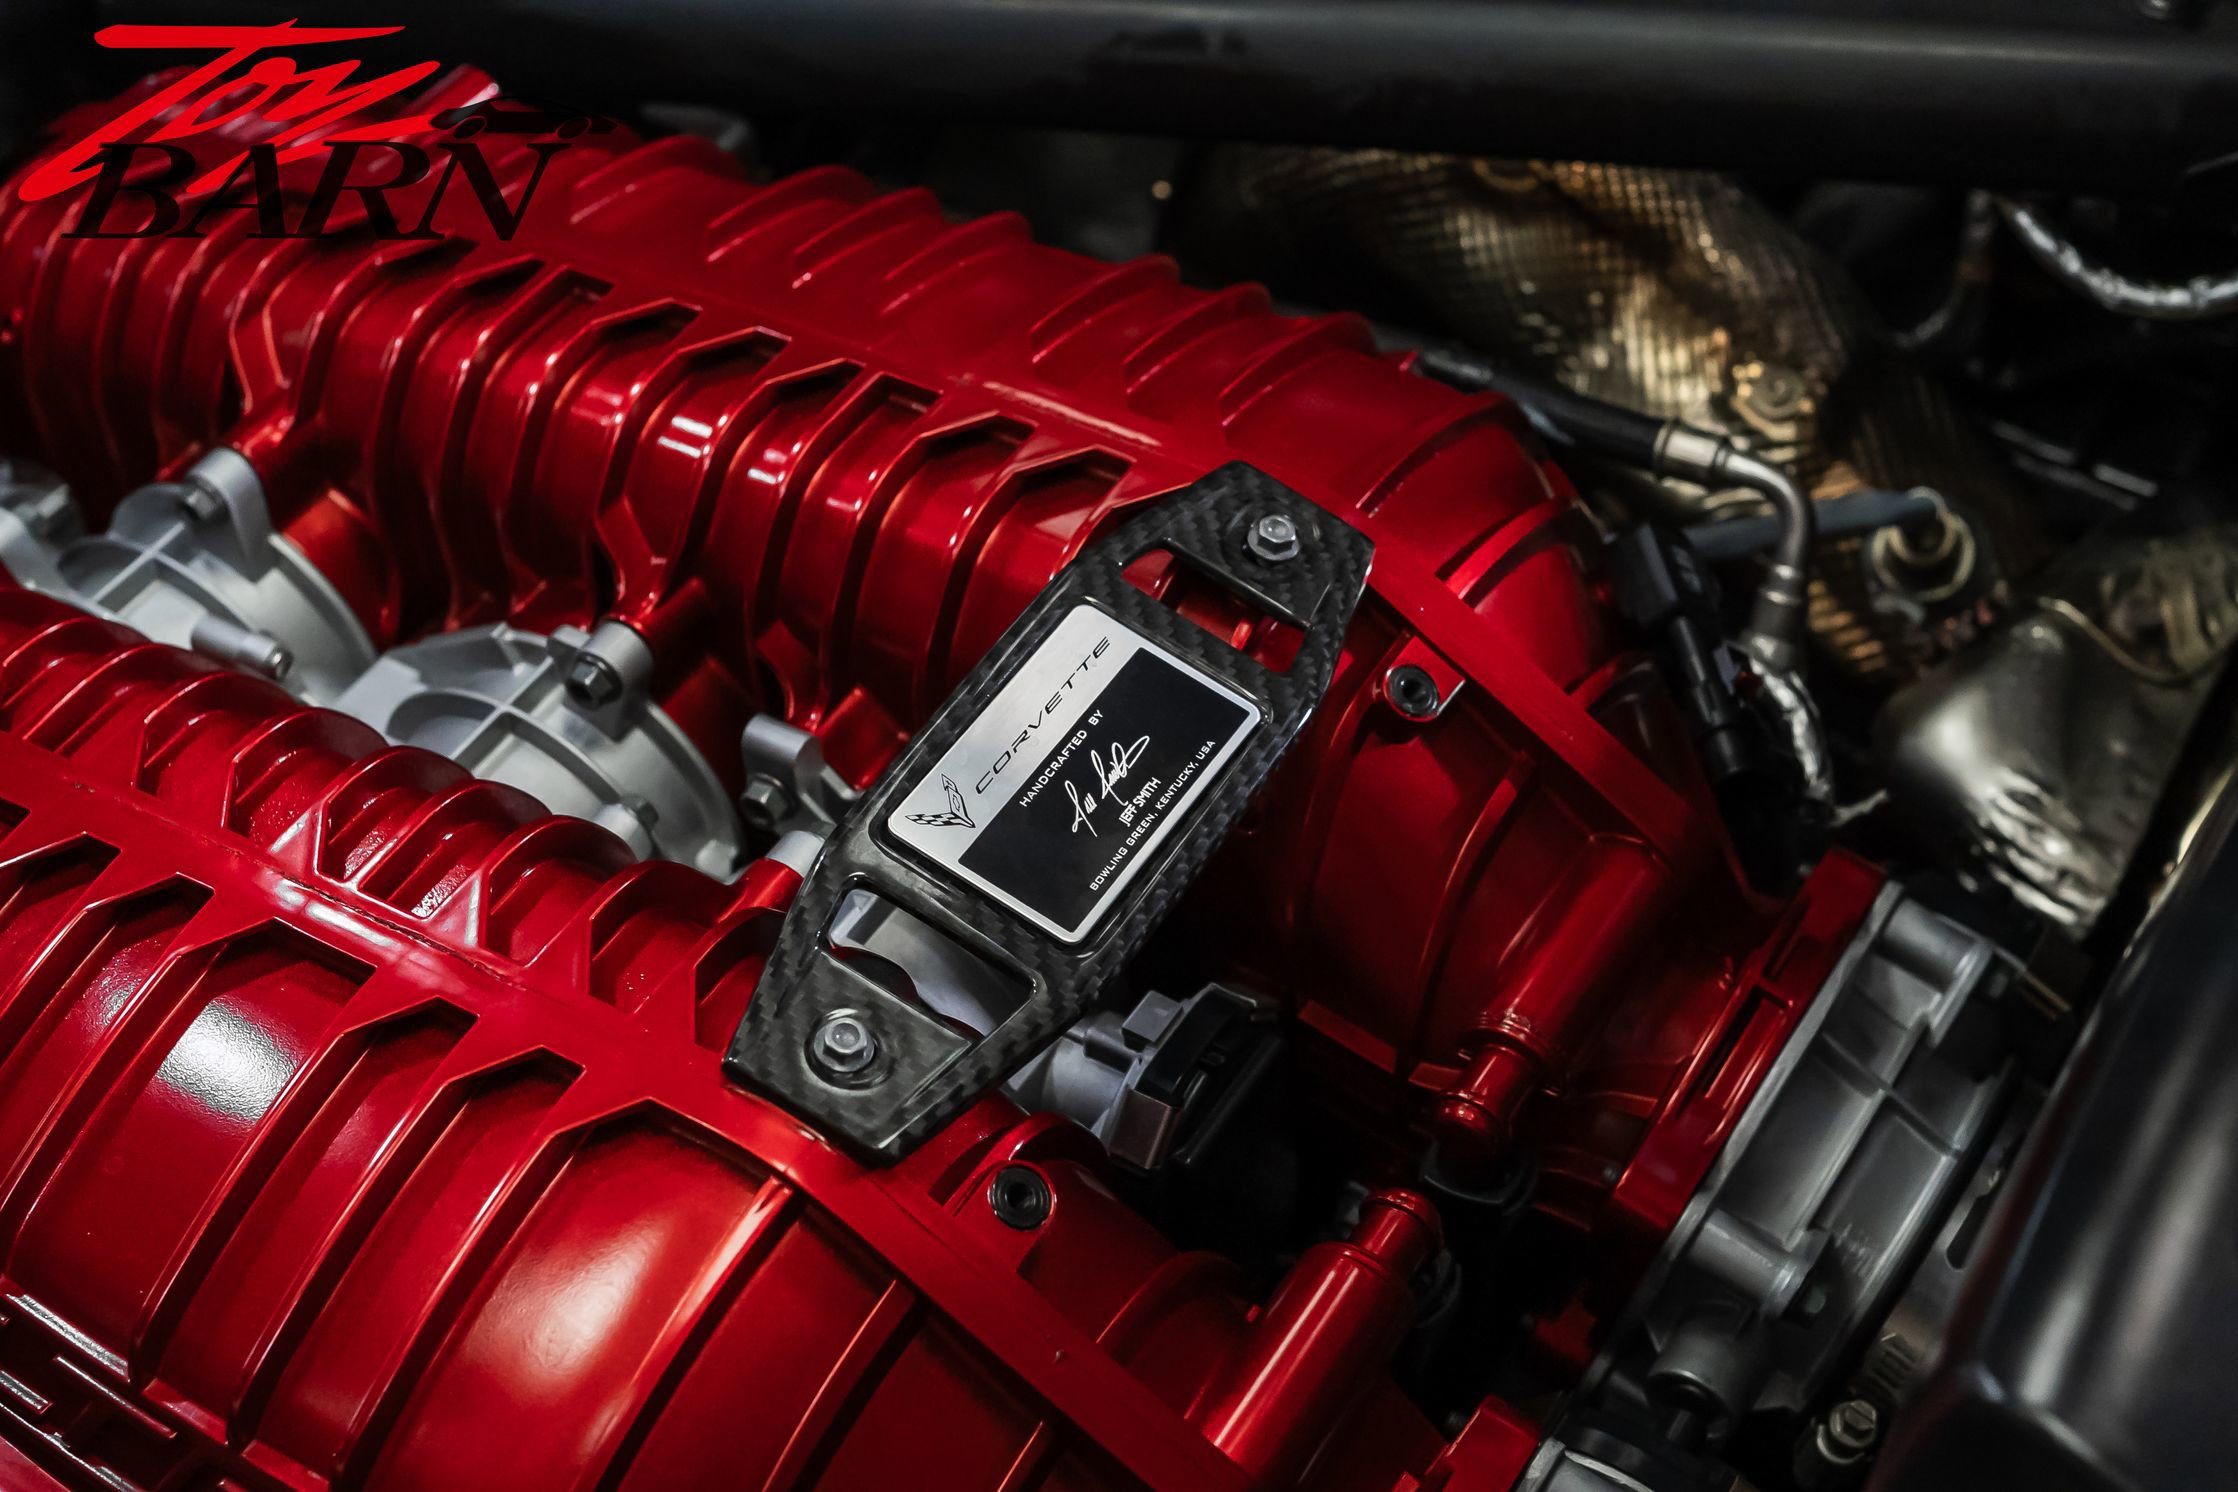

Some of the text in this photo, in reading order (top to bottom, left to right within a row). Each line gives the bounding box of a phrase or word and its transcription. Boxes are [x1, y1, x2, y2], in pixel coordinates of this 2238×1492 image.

[975, 636, 1111, 794] CORVETTE
[1019, 709, 1103, 807] HANDCRAFTED BY
[1089, 740, 1216, 891] BOWLING GREEN, KENTUCKY, USA
[1118, 776, 1162, 827] JEFF SMITH
